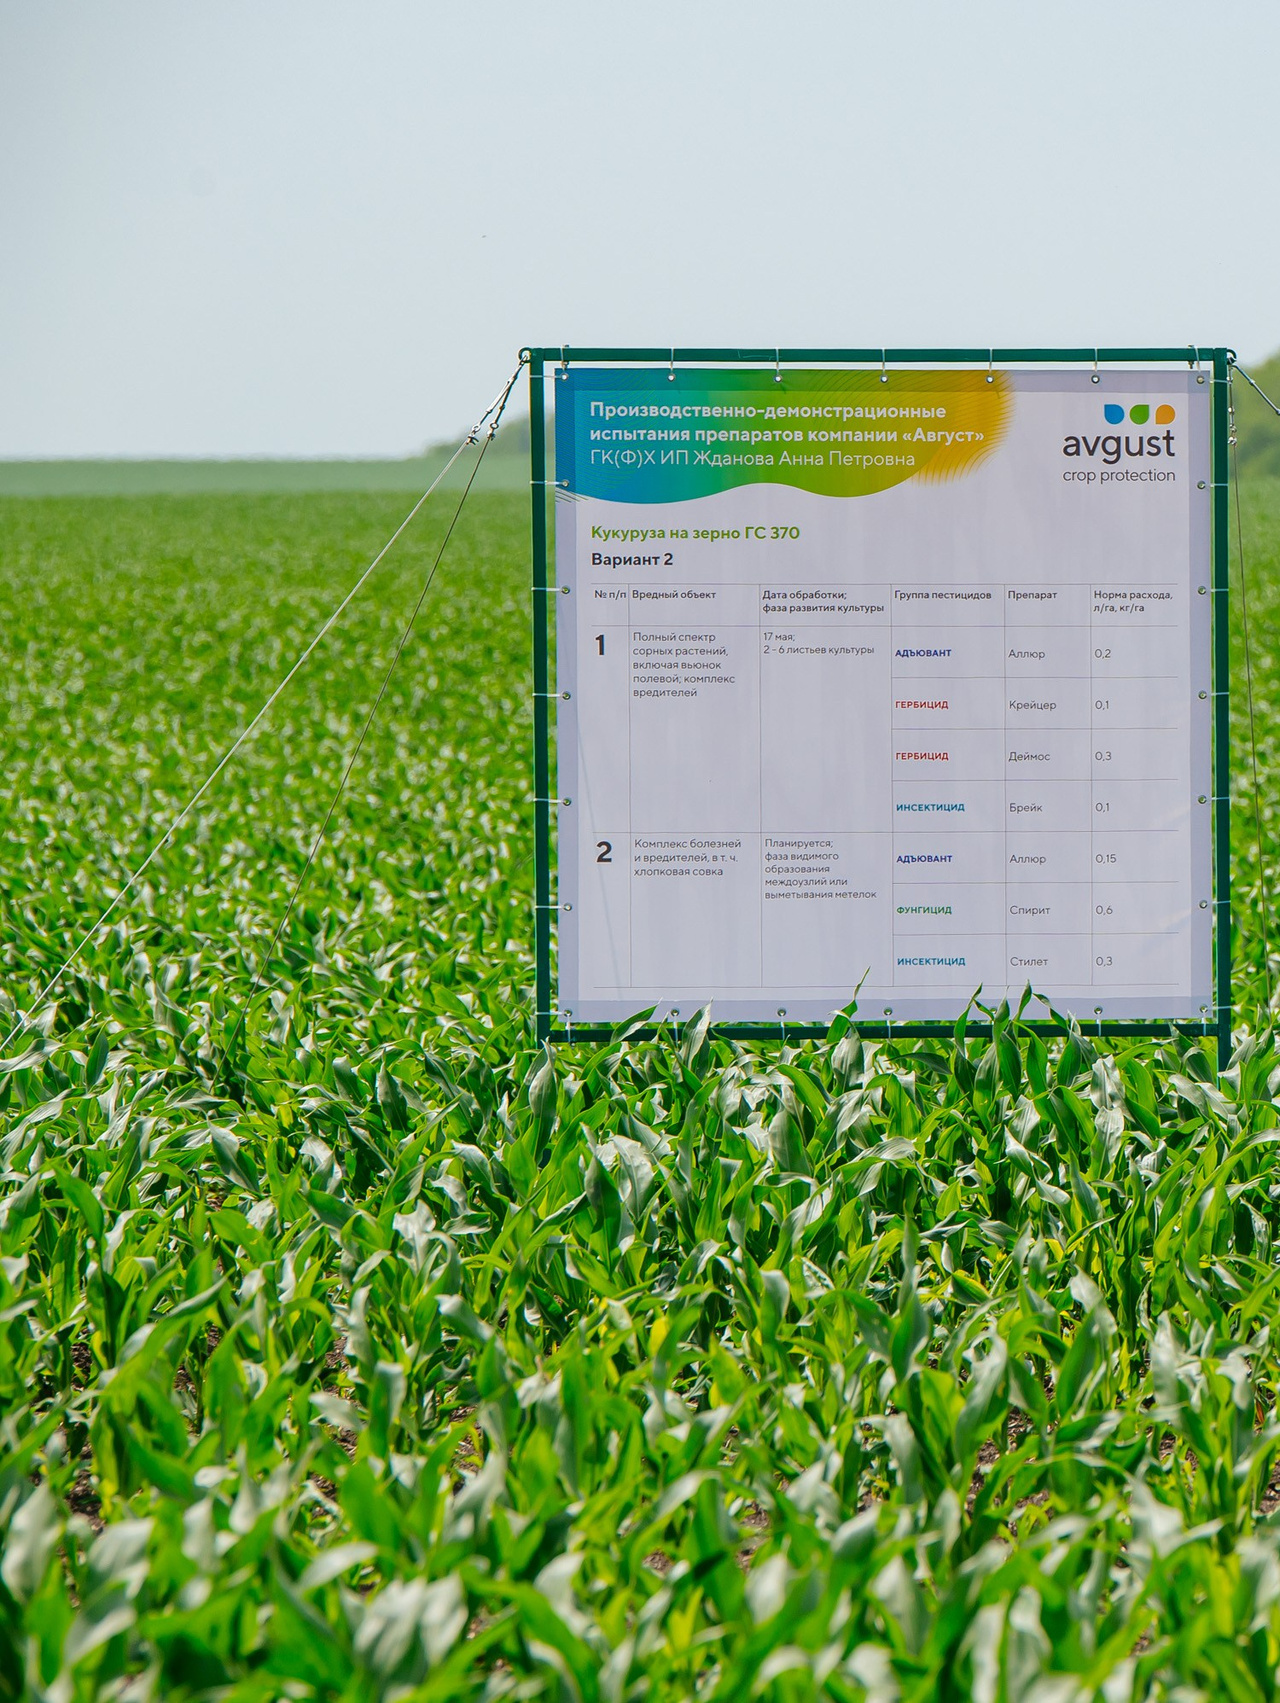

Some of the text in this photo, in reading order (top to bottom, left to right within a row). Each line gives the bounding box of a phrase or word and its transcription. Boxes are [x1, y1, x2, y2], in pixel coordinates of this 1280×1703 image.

[591, 401, 946, 422] Производственно-демонстрационные
[590, 428, 985, 446] испытания препаратов компании «Август»
[1063, 430, 1175, 464] avgust
[591, 450, 915, 469] ГК(Ф)Х ИП Жданова Анна Петровна
[1063, 469, 1175, 484] crop protection
[592, 526, 800, 542] Кукуруза на зерно ГС 370
[592, 553, 673, 569] Вариант 2
[594, 589, 627, 601] № п/п
[632, 589, 717, 601] Вредный объект
[762, 589, 847, 602] Дата обработки;
[894, 589, 992, 602] Группа пестицидов
[1007, 590, 1058, 602] Препарат
[1093, 590, 1173, 601] Норма расхода,
[762, 603, 885, 615] фаза развития культуры
[1093, 603, 1145, 615] л/га, кг/га
[633, 631, 716, 644] Полный спектр
[763, 631, 796, 642] 17 мая;
[596, 635, 604, 655] 1
[763, 644, 770, 655] 2
[777, 645, 785, 655] 6
[786, 647, 827, 655] листьев
[828, 646, 875, 656] культуры
[632, 646, 729, 658] сорных растений,
[894, 648, 952, 658] АДЪЮВАНТ
[1007, 648, 1046, 661] Аллюр
[1094, 648, 1112, 660] 0,2
[632, 662, 722, 670] включая вьюнок
[633, 673, 736, 685] полевой; комплекс
[633, 688, 698, 699] вредителей
[895, 700, 949, 710] ГЕРБИЦИД
[1009, 700, 1057, 712] Крейцер
[1094, 699, 1109, 711] 0,1
[895, 752, 949, 761] ГЕРБИЦИД
[1008, 751, 1051, 763] Деймос
[1094, 750, 1112, 762] 0,3
[896, 803, 966, 813] ИНСЕКТИЦИД
[1009, 802, 1043, 814] Брейк
[1095, 802, 1110, 813] 0,1
[634, 838, 742, 849] Комплекс болезней
[764, 838, 834, 850] Планируется;
[597, 841, 612, 862] 2
[764, 851, 840, 863] фаза видимого
[643, 852, 711, 865] вредителей,
[711, 854, 719, 862] в
[719, 854, 728, 863] т.
[729, 855, 739, 863] ч.
[896, 854, 953, 864] АДЪЮВАНТ
[1009, 854, 1047, 866] Аллюр
[1095, 853, 1117, 864] 0,15
[633, 868, 724, 877] хлопковая совка
[764, 864, 830, 876] образования
[764, 877, 827, 888] междоузлий
[764, 891, 877, 900] выметывания метелок
[896, 905, 953, 916] ФУНГИЦИД
[1009, 905, 1051, 917] Спирит
[1095, 904, 1114, 916] 0,6
[897, 957, 966, 967] ИНСЕКТИЦИД
[1009, 956, 1049, 967] Стилет
[1095, 955, 1113, 967] 0,3
